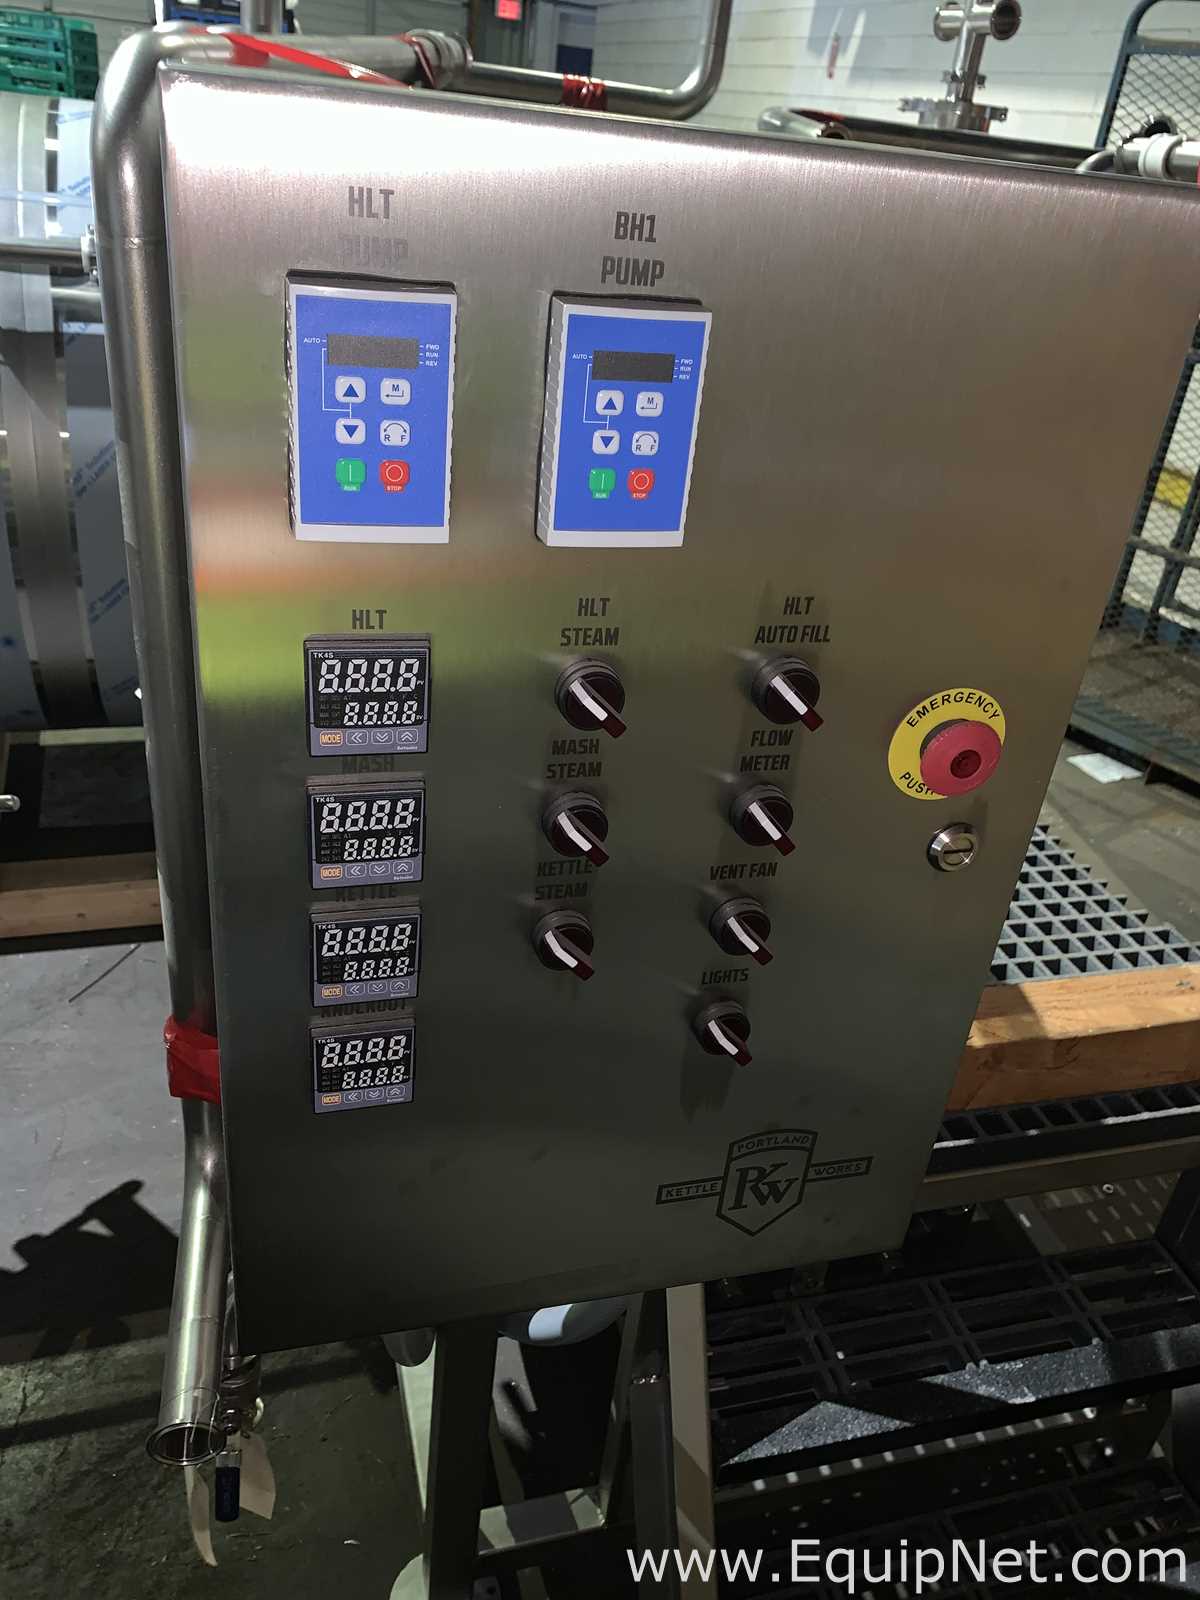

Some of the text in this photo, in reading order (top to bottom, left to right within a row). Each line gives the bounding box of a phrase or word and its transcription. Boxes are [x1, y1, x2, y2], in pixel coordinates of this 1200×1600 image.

[348, 186, 395, 219] HLT
[614, 211, 657, 243] BH1
[338, 234, 409, 269] PUMP
[601, 256, 665, 287] PUMP
[391, 384, 400, 392] M
[578, 598, 611, 616] HLT
[783, 597, 814, 615] HLT
[352, 609, 388, 630] HLT
[560, 627, 620, 646] STEAM
[755, 625, 831, 644] AUTO FILL
[906, 691, 1000, 728] EMERGENCY
[321, 734, 342, 743] MODE
[750, 729, 794, 746] FLOW
[552, 739, 600, 755] MASH
[343, 754, 395, 773] MASH
[546, 762, 602, 779] STEAM
[740, 754, 790, 772] METER
[900, 771, 935, 796] PUS
[322, 868, 341, 877] MODE
[537, 860, 593, 877] KETTLE
[710, 862, 778, 880] VENT FAN
[535, 881, 588, 900] STEAM
[702, 968, 749, 985] LIGHTS
[323, 1095, 340, 1103] MODE
[736, 1135, 810, 1152] PORTLAND
[814, 1162, 863, 1176] WORKS
[665, 1182, 720, 1198] KETTLE
